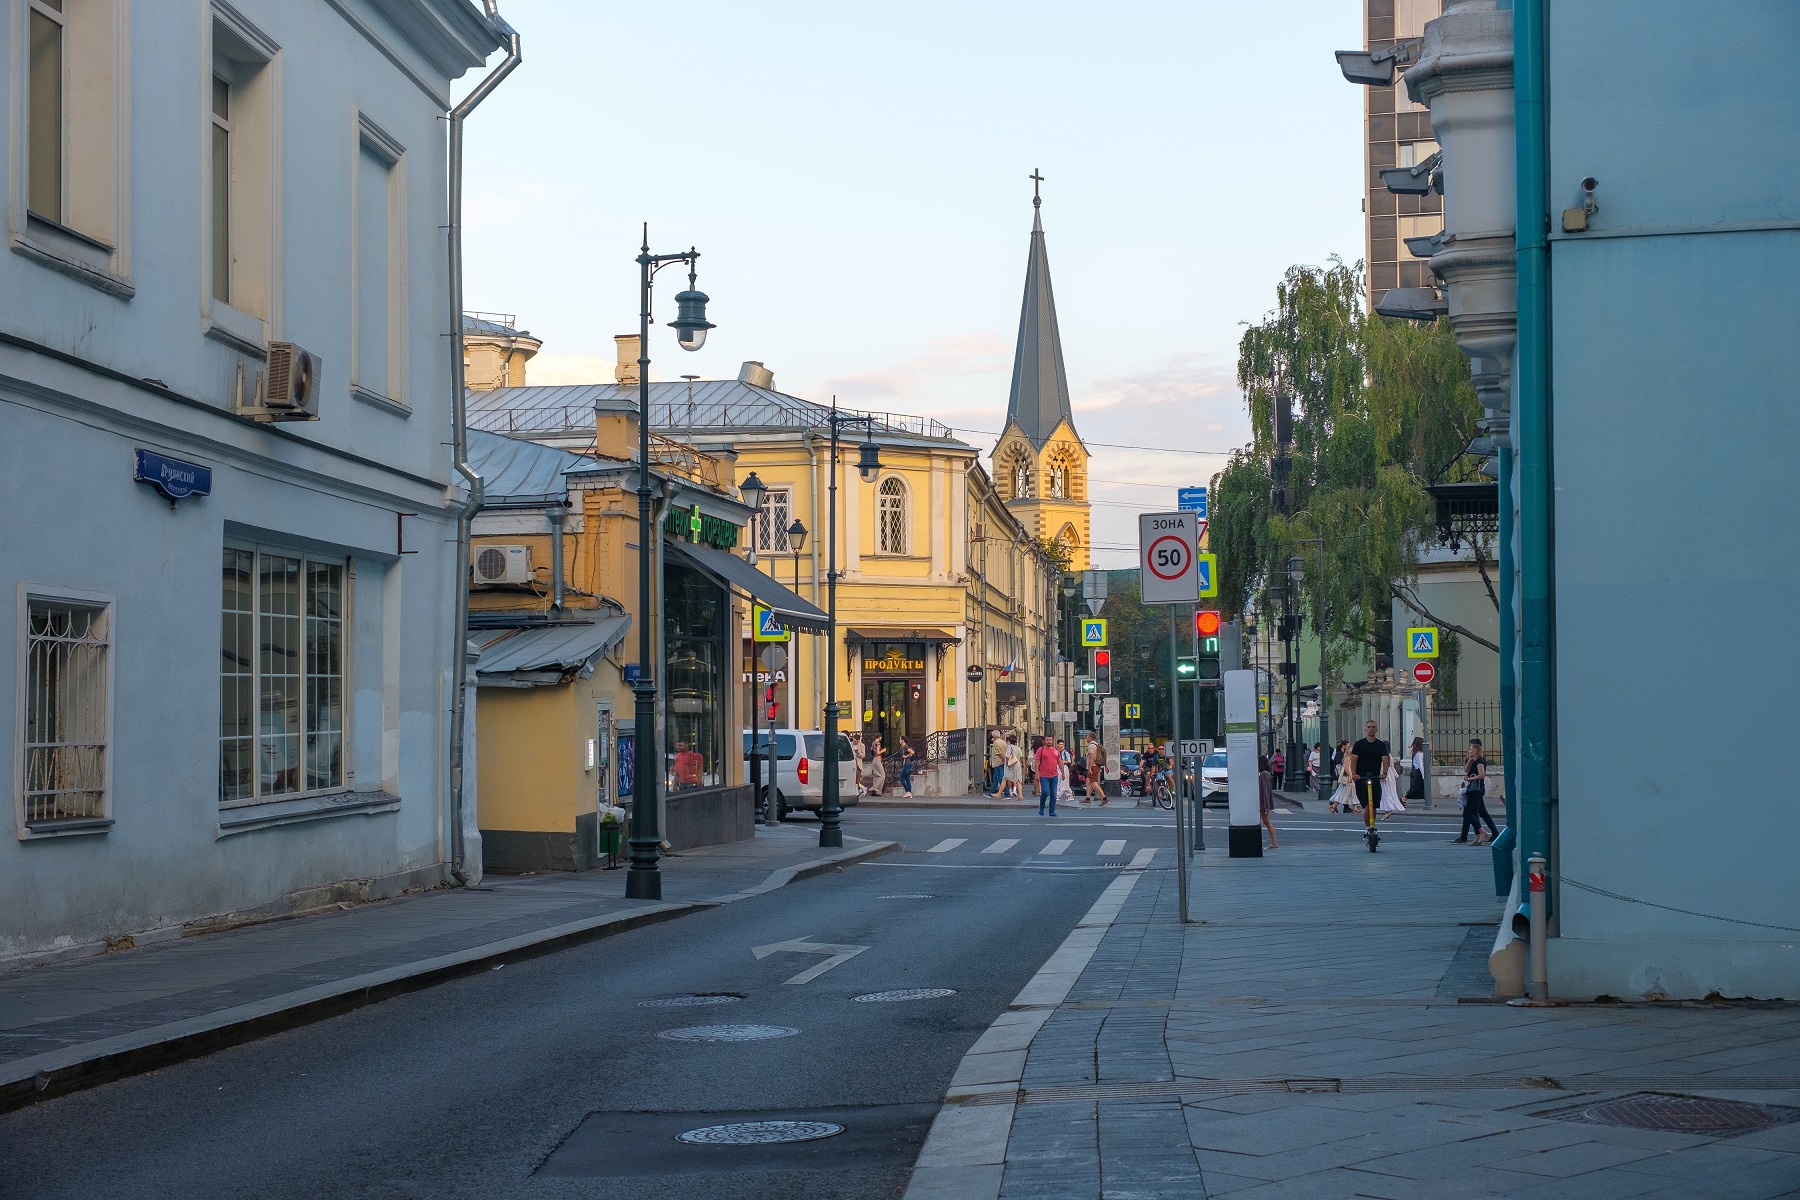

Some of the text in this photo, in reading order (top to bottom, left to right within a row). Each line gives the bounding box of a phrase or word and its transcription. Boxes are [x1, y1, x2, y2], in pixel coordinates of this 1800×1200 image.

[1152, 519, 1185, 530] ЗОНА
[1157, 549, 1181, 567] 50
[1205, 637, 1218, 652] 17
[865, 660, 924, 670] ПРОДУКТЫ
